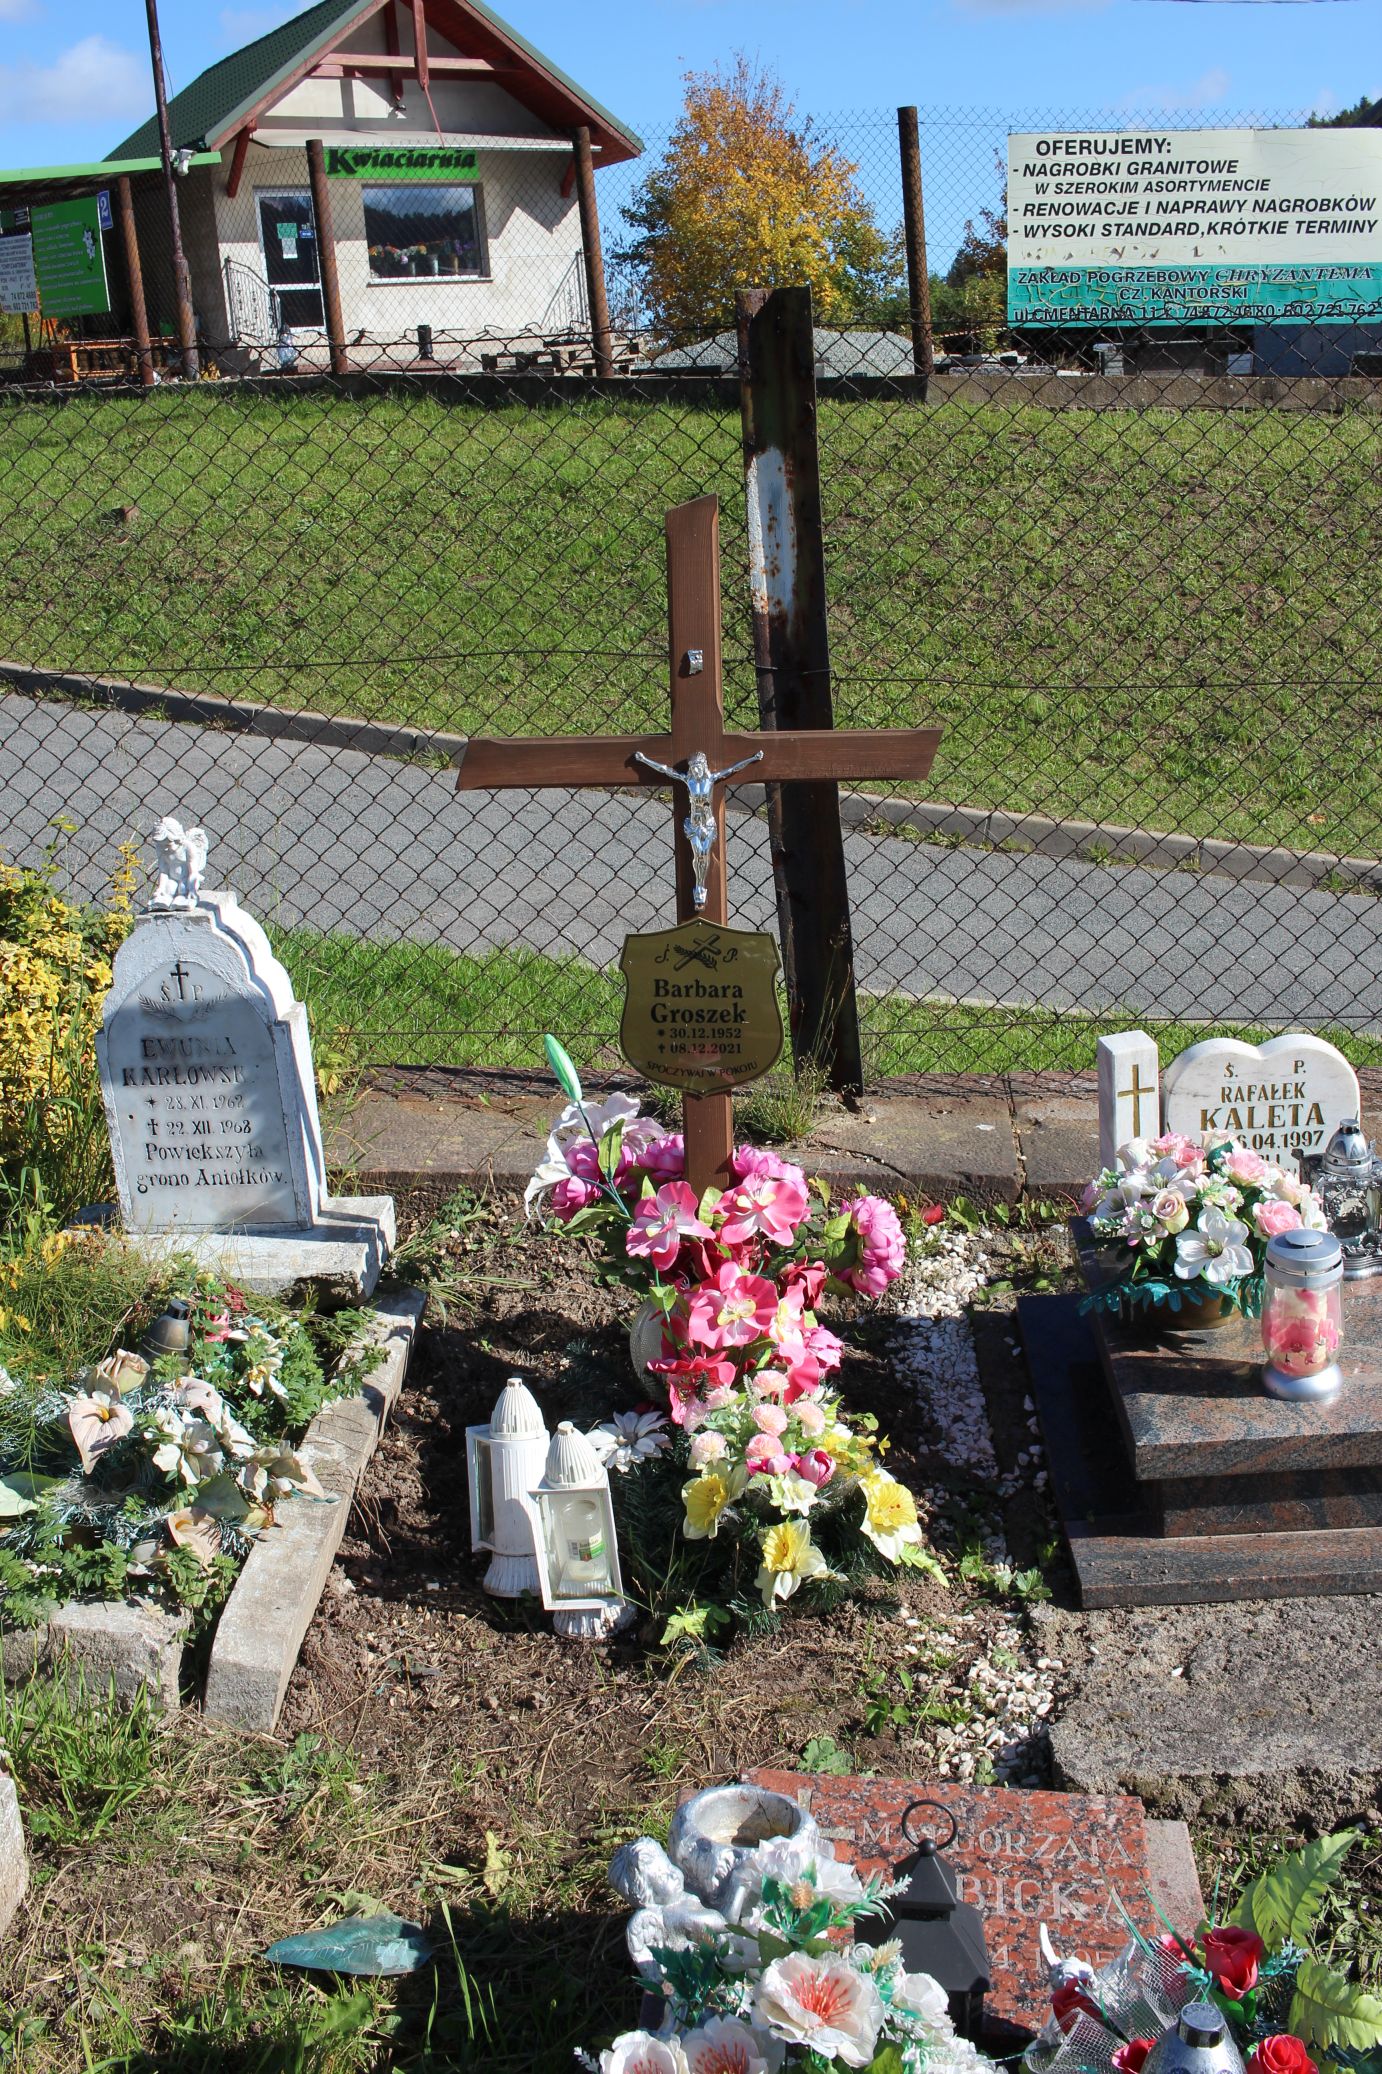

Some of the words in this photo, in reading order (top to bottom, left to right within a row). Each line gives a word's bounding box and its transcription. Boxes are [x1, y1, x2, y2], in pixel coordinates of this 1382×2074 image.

[1036, 138, 1172, 156] OFERUJEMY:
[327, 149, 475, 175] Kwiaciarnia
[1023, 162, 1121, 177] NAGROBKI
[1127, 160, 1239, 175] GRANITOWE
[1035, 183, 1049, 195] W
[1054, 182, 1139, 195] SZEROKIM
[1143, 179, 1271, 193] ASORTYMENCIE
[101, 197, 110, 217] 2
[1023, 201, 1139, 216] RENOWACJE
[1145, 201, 1150, 215] I
[1156, 200, 1248, 214] NAPRAWY
[1252, 194, 1377, 213] NAGROBKÓW
[1024, 223, 1095, 238] WYSOKI
[1296, 220, 1378, 234] TERMINY
[1018, 271, 1081, 284] ZAKŁAD
[1087, 270, 1211, 284] POGRZEBOWY
[1215, 267, 1373, 281] CHRYZANTEMA
[653, 979, 743, 999] Barbara
[651, 1002, 747, 1024] Groszek
[670, 1028, 742, 1039] 30.12.1952
[670, 1043, 742, 1054] 08.12.2021
[1293, 1059, 1306, 1074] P.
[1220, 1081, 1307, 1103] RAFAŁEK
[1200, 1102, 1325, 1131] KALETA
[136, 1173, 190, 1194] grono
